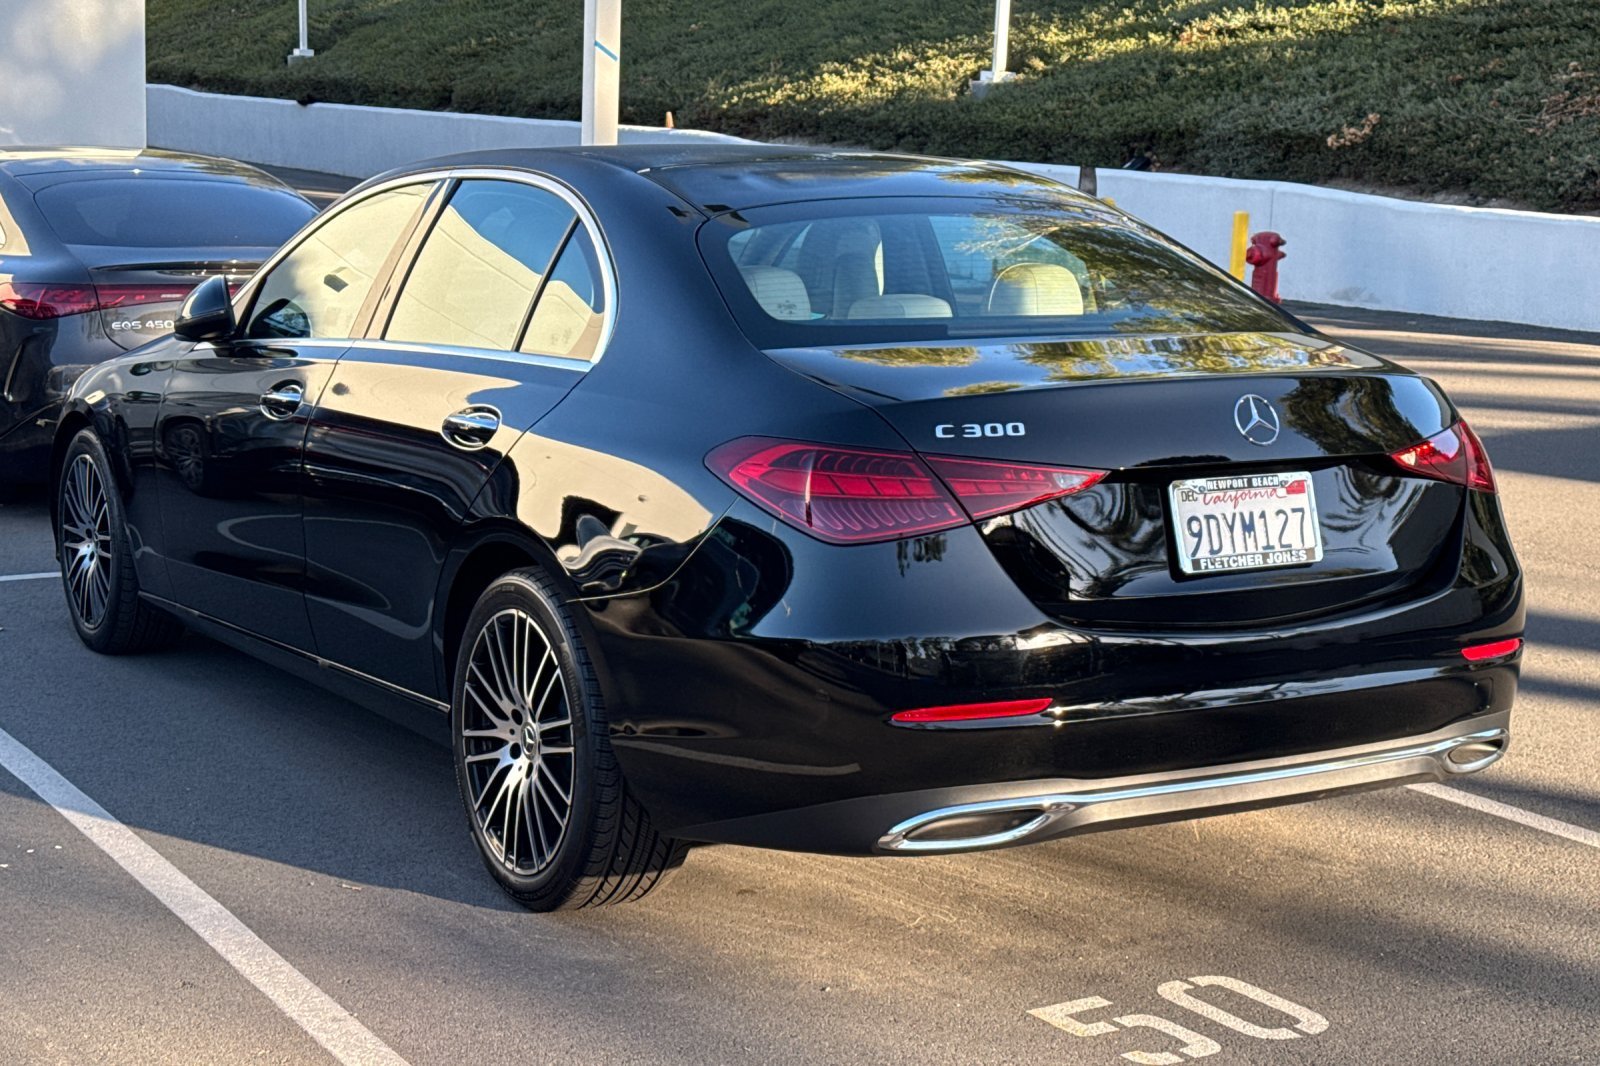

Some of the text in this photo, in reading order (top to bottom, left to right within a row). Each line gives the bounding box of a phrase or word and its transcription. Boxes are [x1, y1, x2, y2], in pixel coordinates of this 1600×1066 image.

[111, 320, 175, 330] EQS 450
[935, 422, 1026, 438] C 300
[1206, 477, 1248, 491] NEWPORT
[1252, 475, 1280, 487] BEACH
[1180, 490, 1198, 502] DEC
[1202, 488, 1288, 509] California
[1186, 507, 1306, 558] 9DYM127
[1200, 550, 1308, 570] FLETCHER JONES
[1026, 975, 1330, 1065] 50
